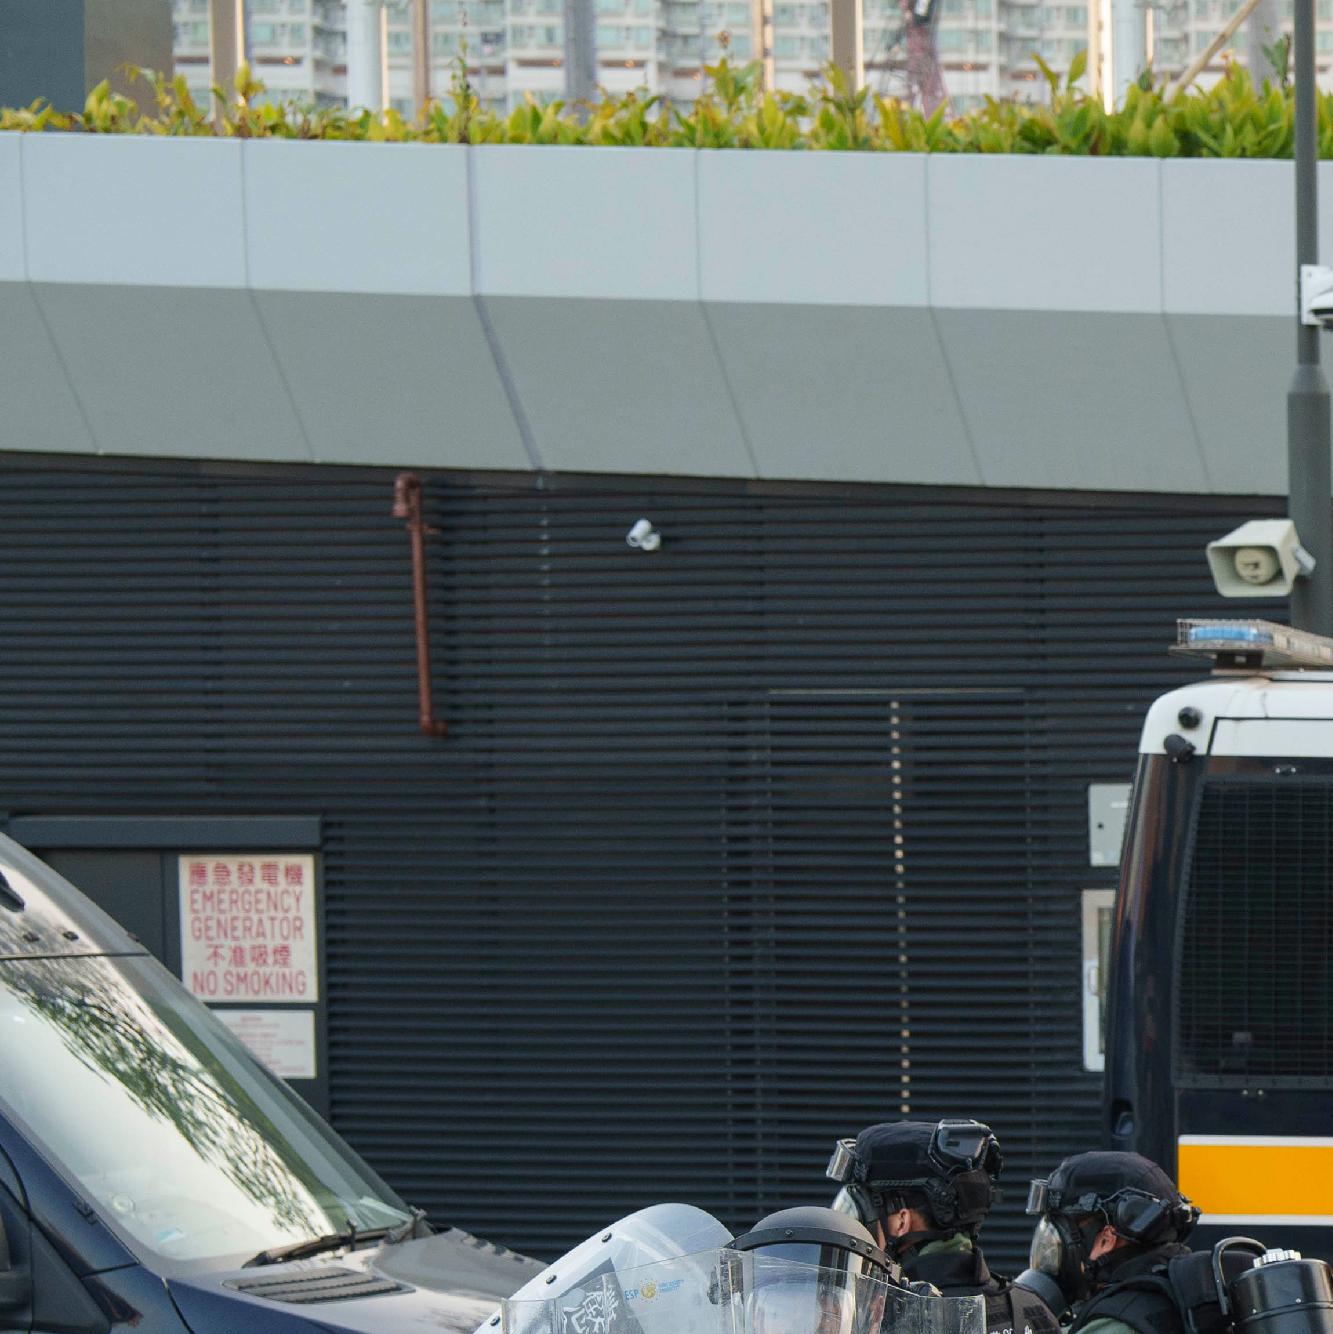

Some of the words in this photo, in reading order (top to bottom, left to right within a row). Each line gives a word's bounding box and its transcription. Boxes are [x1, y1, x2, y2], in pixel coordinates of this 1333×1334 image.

[189, 862, 304, 887] 應急發電機
[190, 889, 303, 914] EMERGENCY
[191, 916, 304, 941] GENERATOR
[206, 944, 291, 968] 不准吸煙
[193, 971, 218, 994] NO
[223, 970, 306, 995] SMOKING
